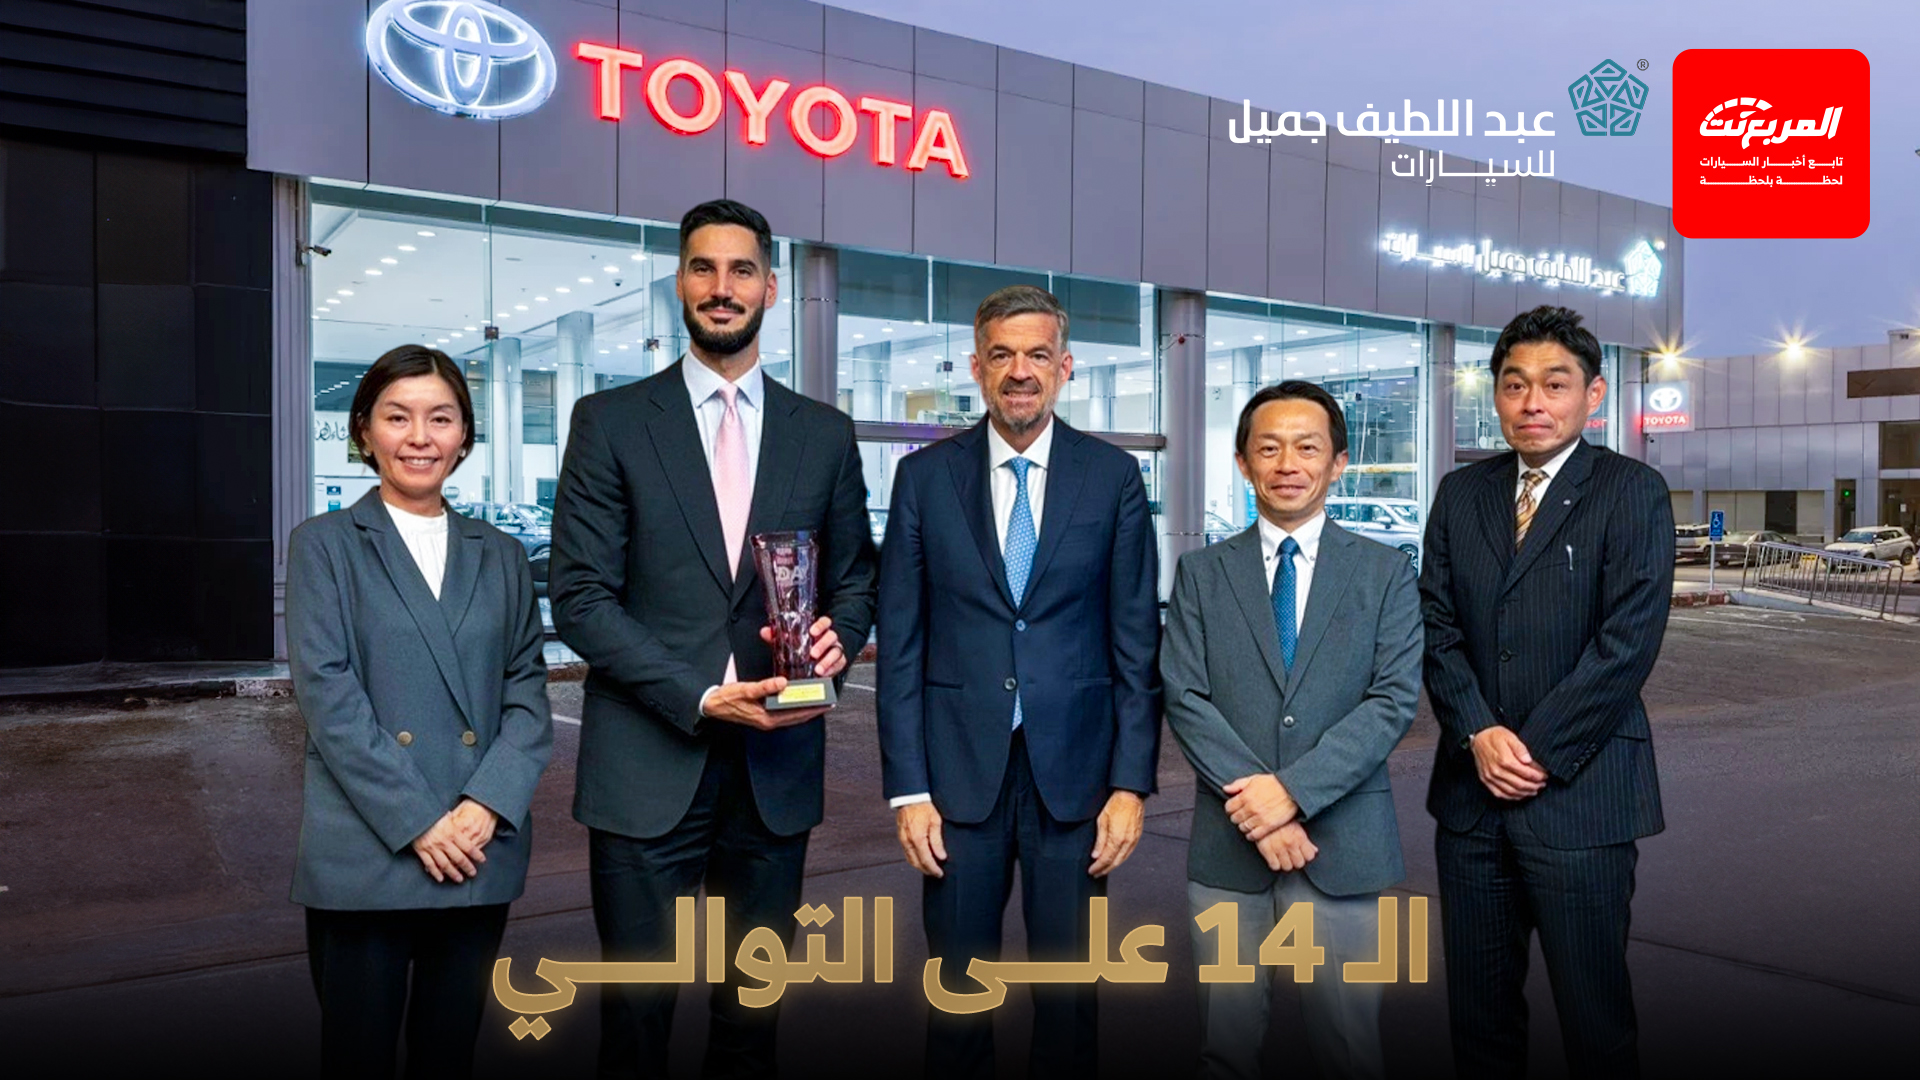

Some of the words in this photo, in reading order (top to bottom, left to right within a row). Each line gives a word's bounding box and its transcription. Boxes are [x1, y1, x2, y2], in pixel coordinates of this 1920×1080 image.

[576, 41, 970, 180] TOYOTA
[1476, 238, 1531, 282] جميل
[1531, 252, 1593, 290] اللطيف
[1590, 267, 1627, 297] عبد
[1643, 415, 1686, 426] TOYOTA
